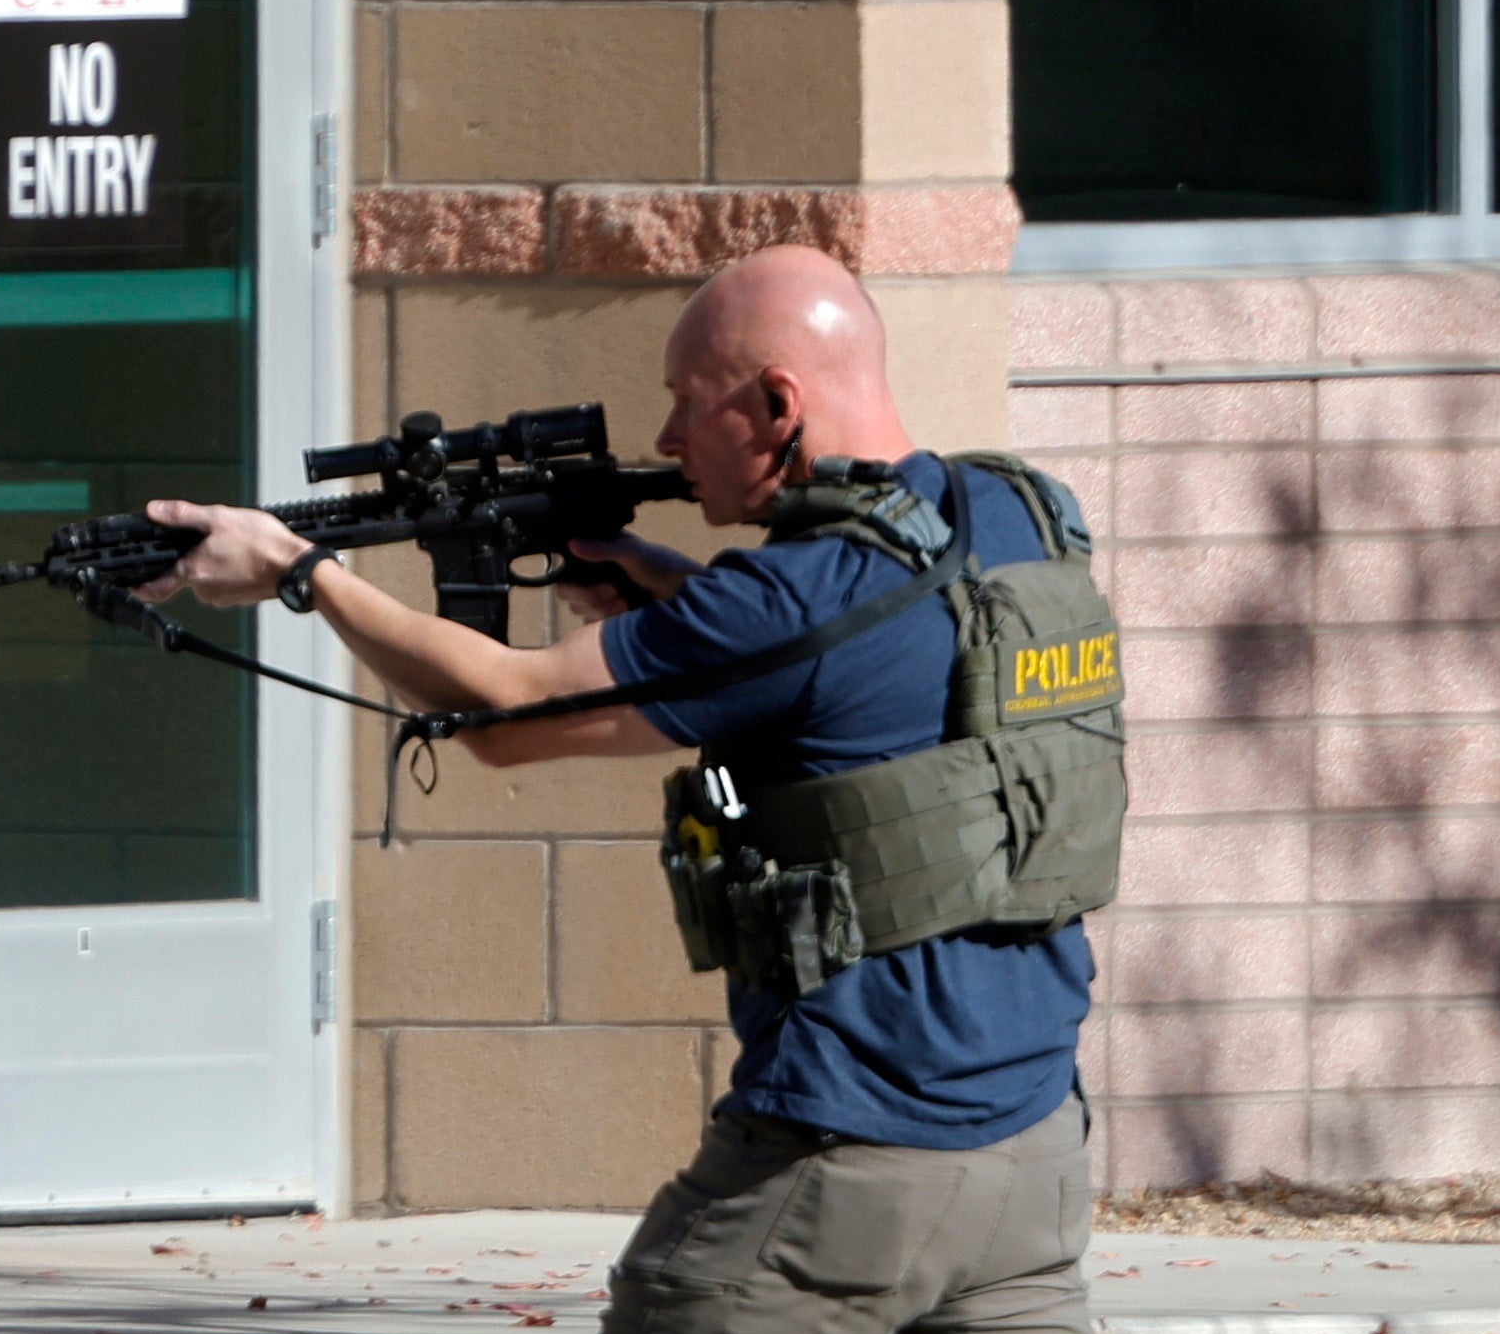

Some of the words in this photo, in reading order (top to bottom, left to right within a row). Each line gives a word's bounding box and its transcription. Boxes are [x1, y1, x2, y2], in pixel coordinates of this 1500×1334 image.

[49, 41, 116, 127] NO
[9, 134, 156, 218] ENTRY
[1015, 632, 1117, 696] POLICE
